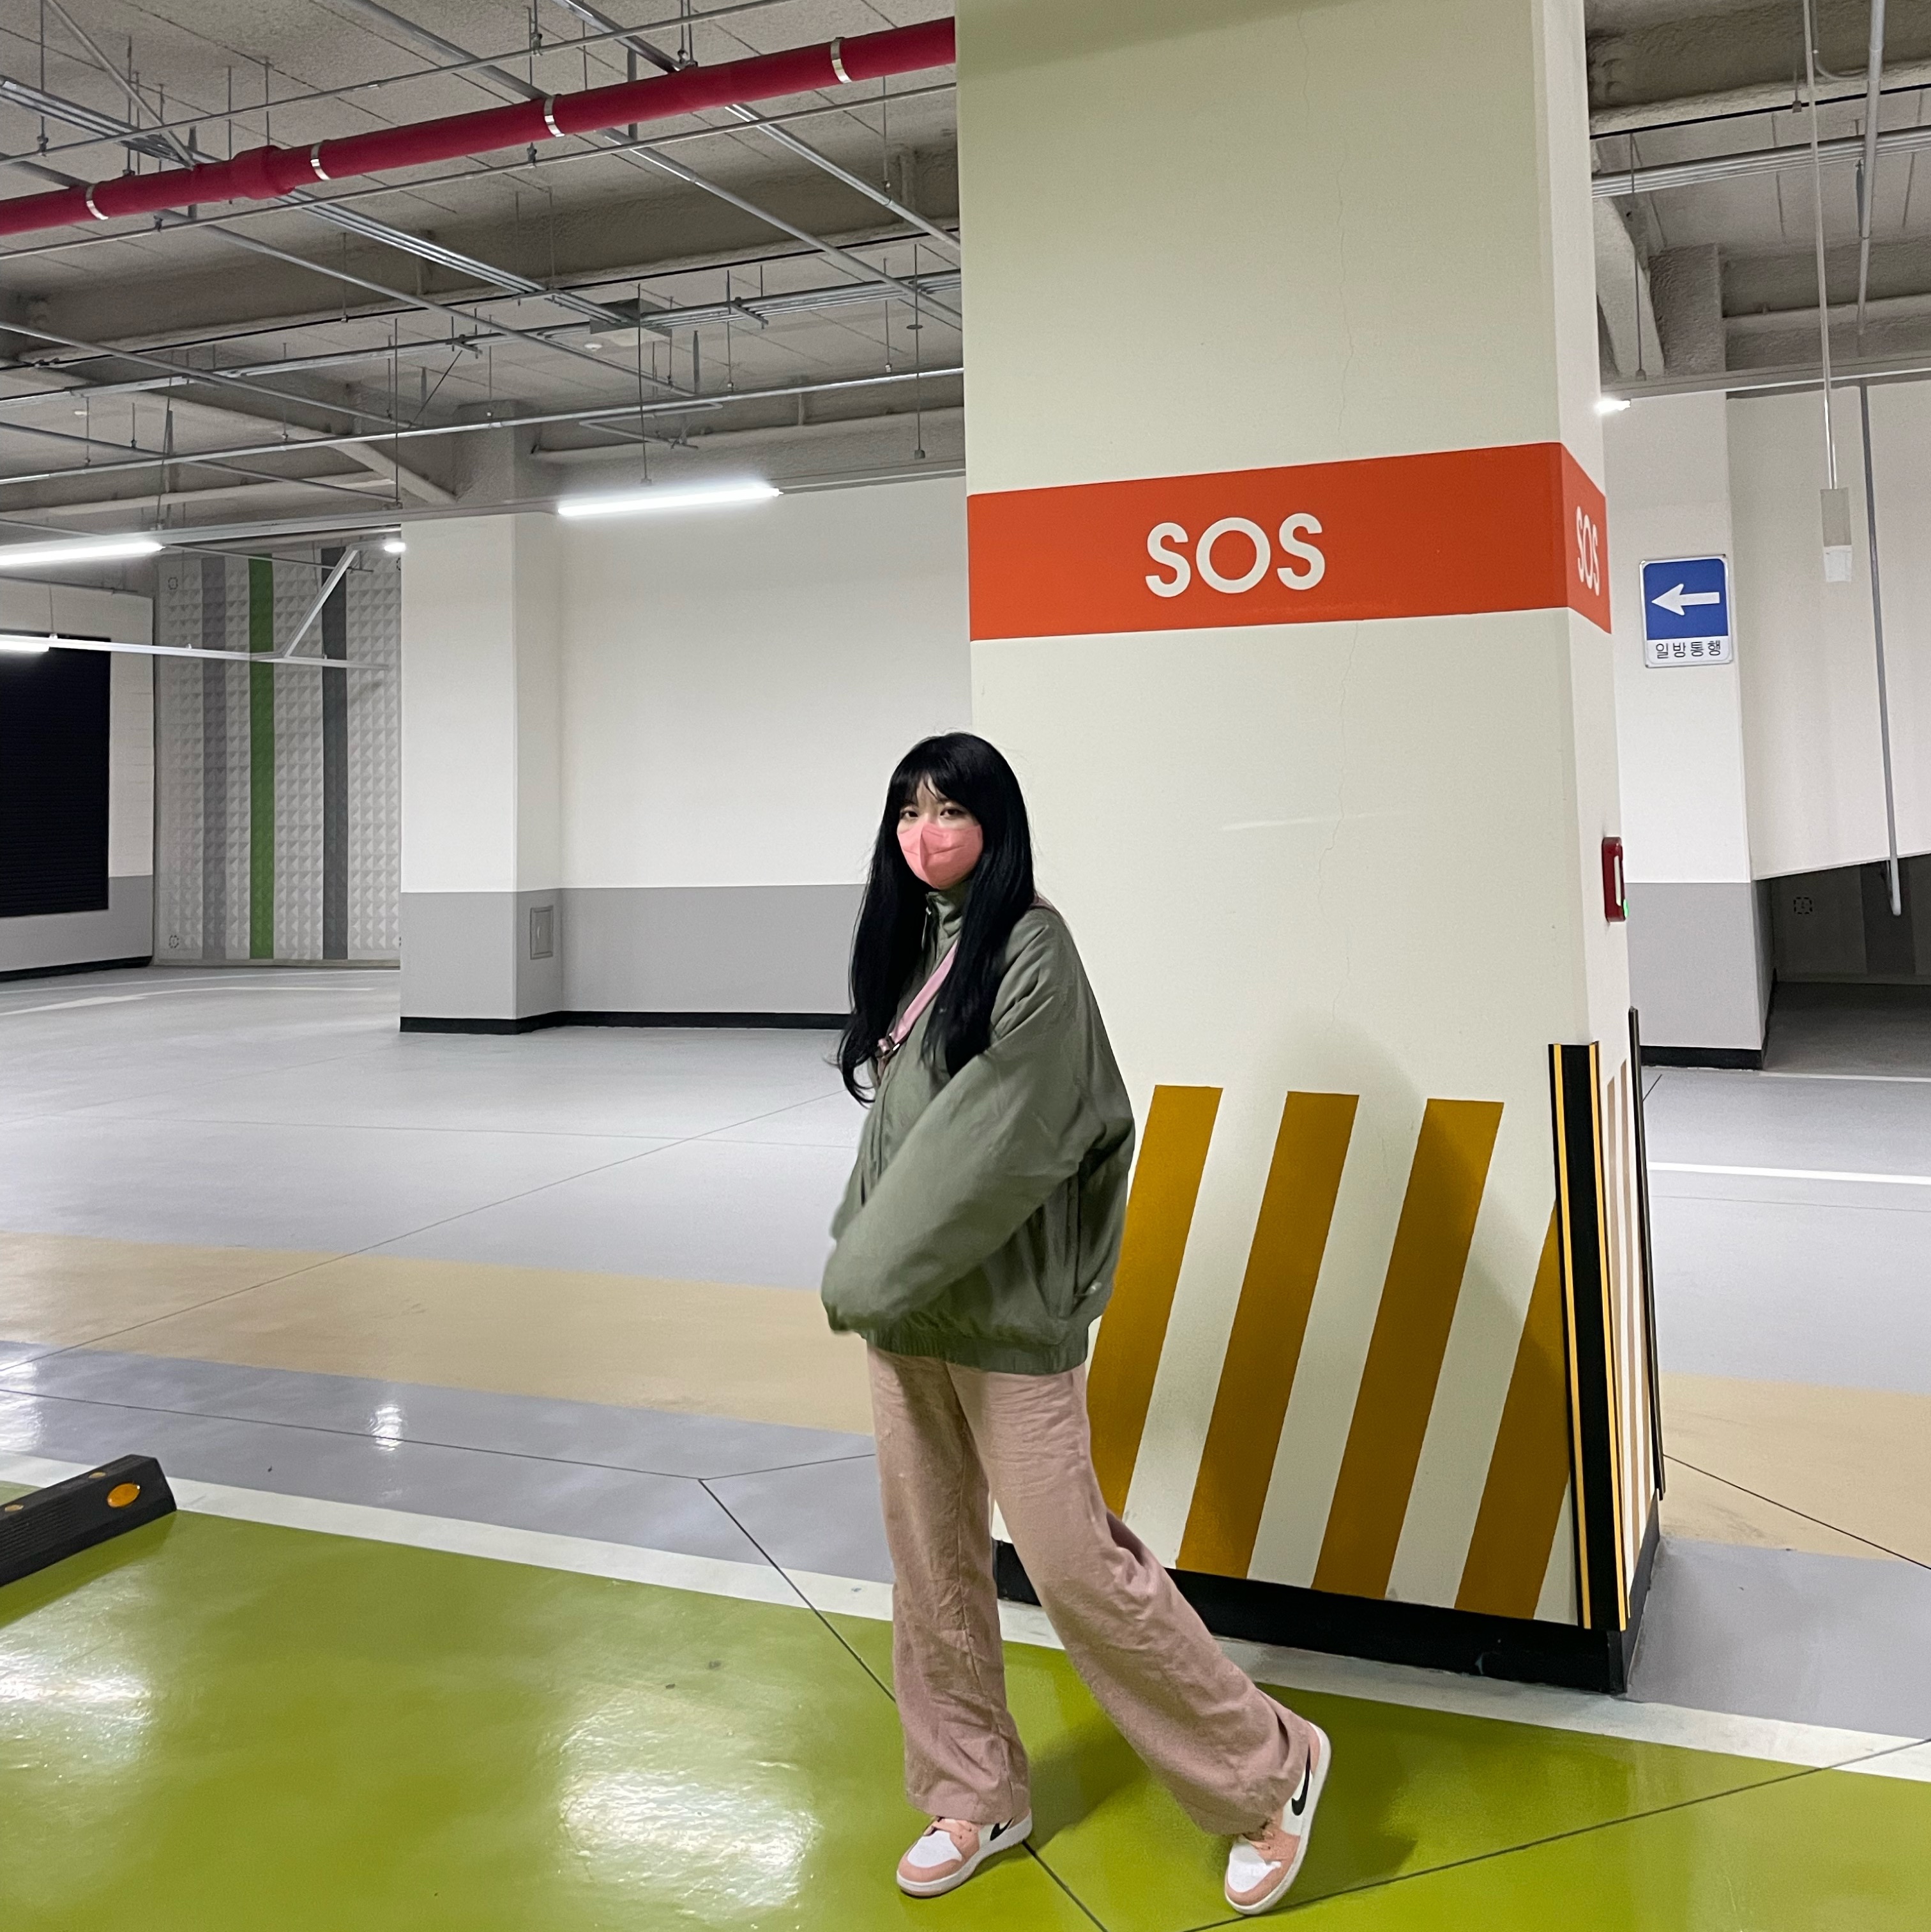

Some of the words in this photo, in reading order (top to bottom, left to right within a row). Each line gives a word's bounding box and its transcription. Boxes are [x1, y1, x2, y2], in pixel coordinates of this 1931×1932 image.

[1145, 512, 1326, 598] SOS
[1575, 505, 1600, 597] SOS
[1655, 640, 1721, 659] 일방통행
